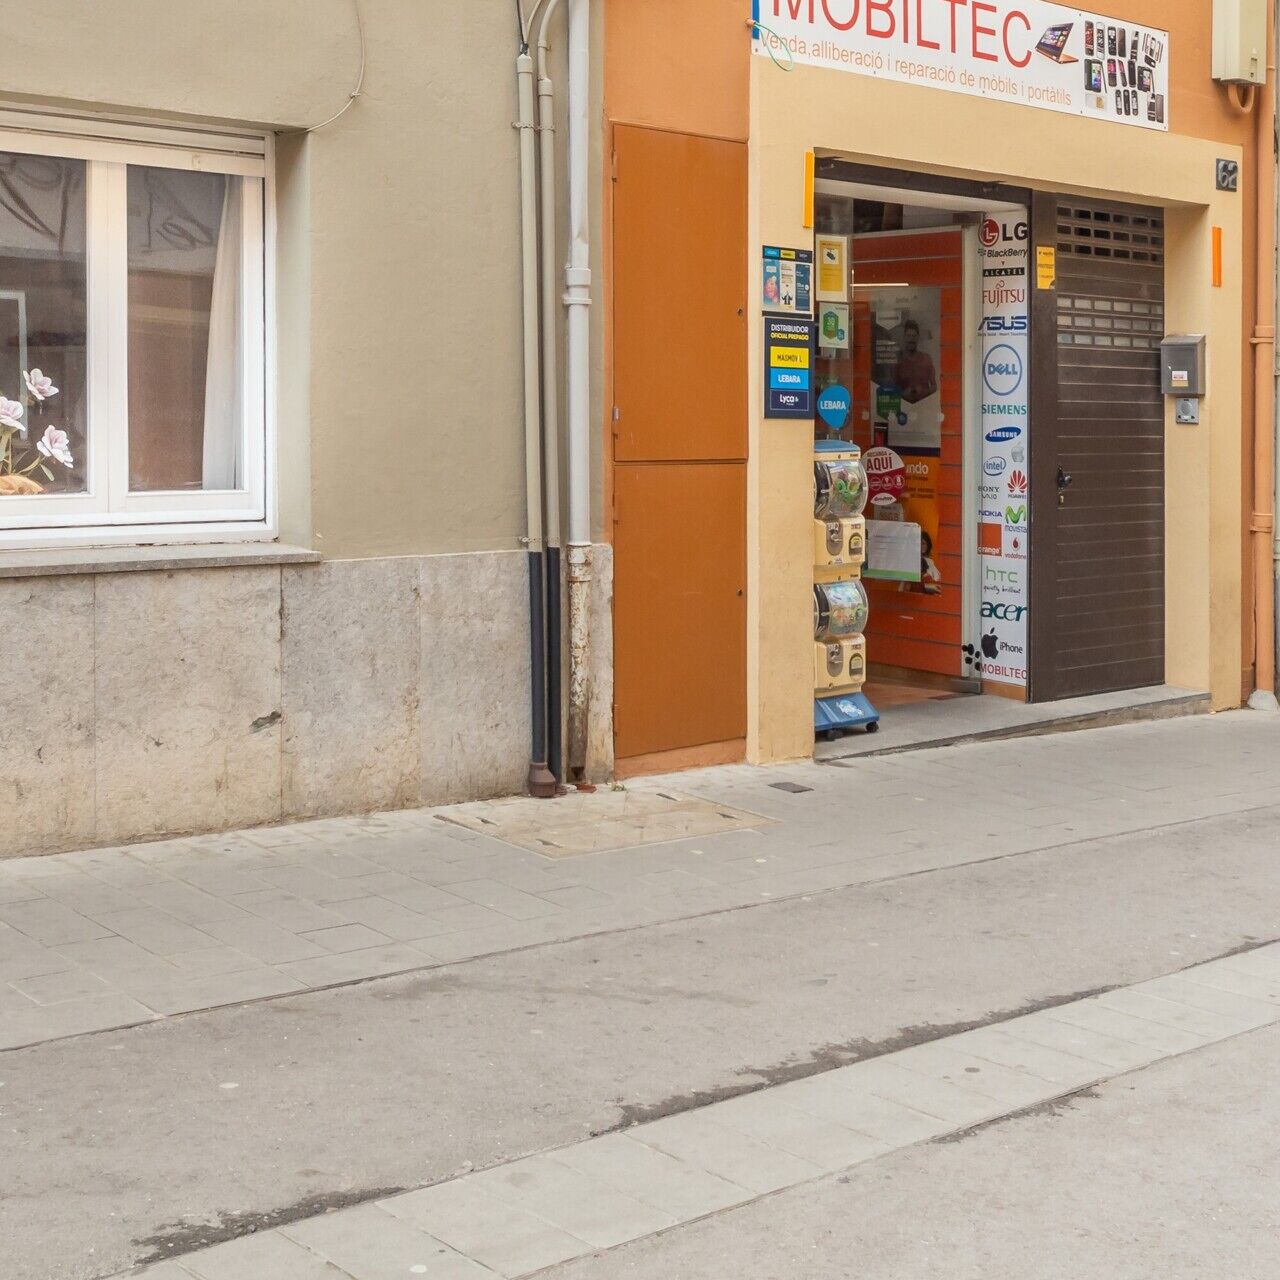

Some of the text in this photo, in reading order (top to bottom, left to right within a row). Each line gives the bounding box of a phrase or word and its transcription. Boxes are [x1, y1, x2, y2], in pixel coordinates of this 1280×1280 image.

[895, 58, 956, 84] reparació
[960, 69, 975, 87] de
[979, 73, 1018, 96] mòbils
[1028, 85, 1072, 106] portàtils
[1218, 160, 1238, 189] 62
[1002, 222, 1028, 241] LG
[987, 248, 1028, 258] BlackBerry
[984, 268, 1022, 276] ALCATEL
[982, 288, 1025, 308] FUJITSU
[771, 324, 809, 333] DISTRIBUIDOR
[978, 315, 1027, 331] ASUS
[788, 333, 809, 341] PREPAGO
[987, 363, 1018, 376] DELL
[778, 375, 801, 383] LEBARA
[779, 394, 795, 404] Lyca
[820, 401, 846, 410] LEBARA
[981, 404, 1027, 415] SIEMENS
[866, 452, 893, 471] AQUÍ
[985, 461, 1003, 471] intel
[977, 547, 1001, 555] orange
[1004, 552, 1027, 560] vodafone
[980, 601, 1027, 622] acer
[1000, 641, 1023, 654] iPhone
[980, 663, 1027, 680] MOBILTEC
